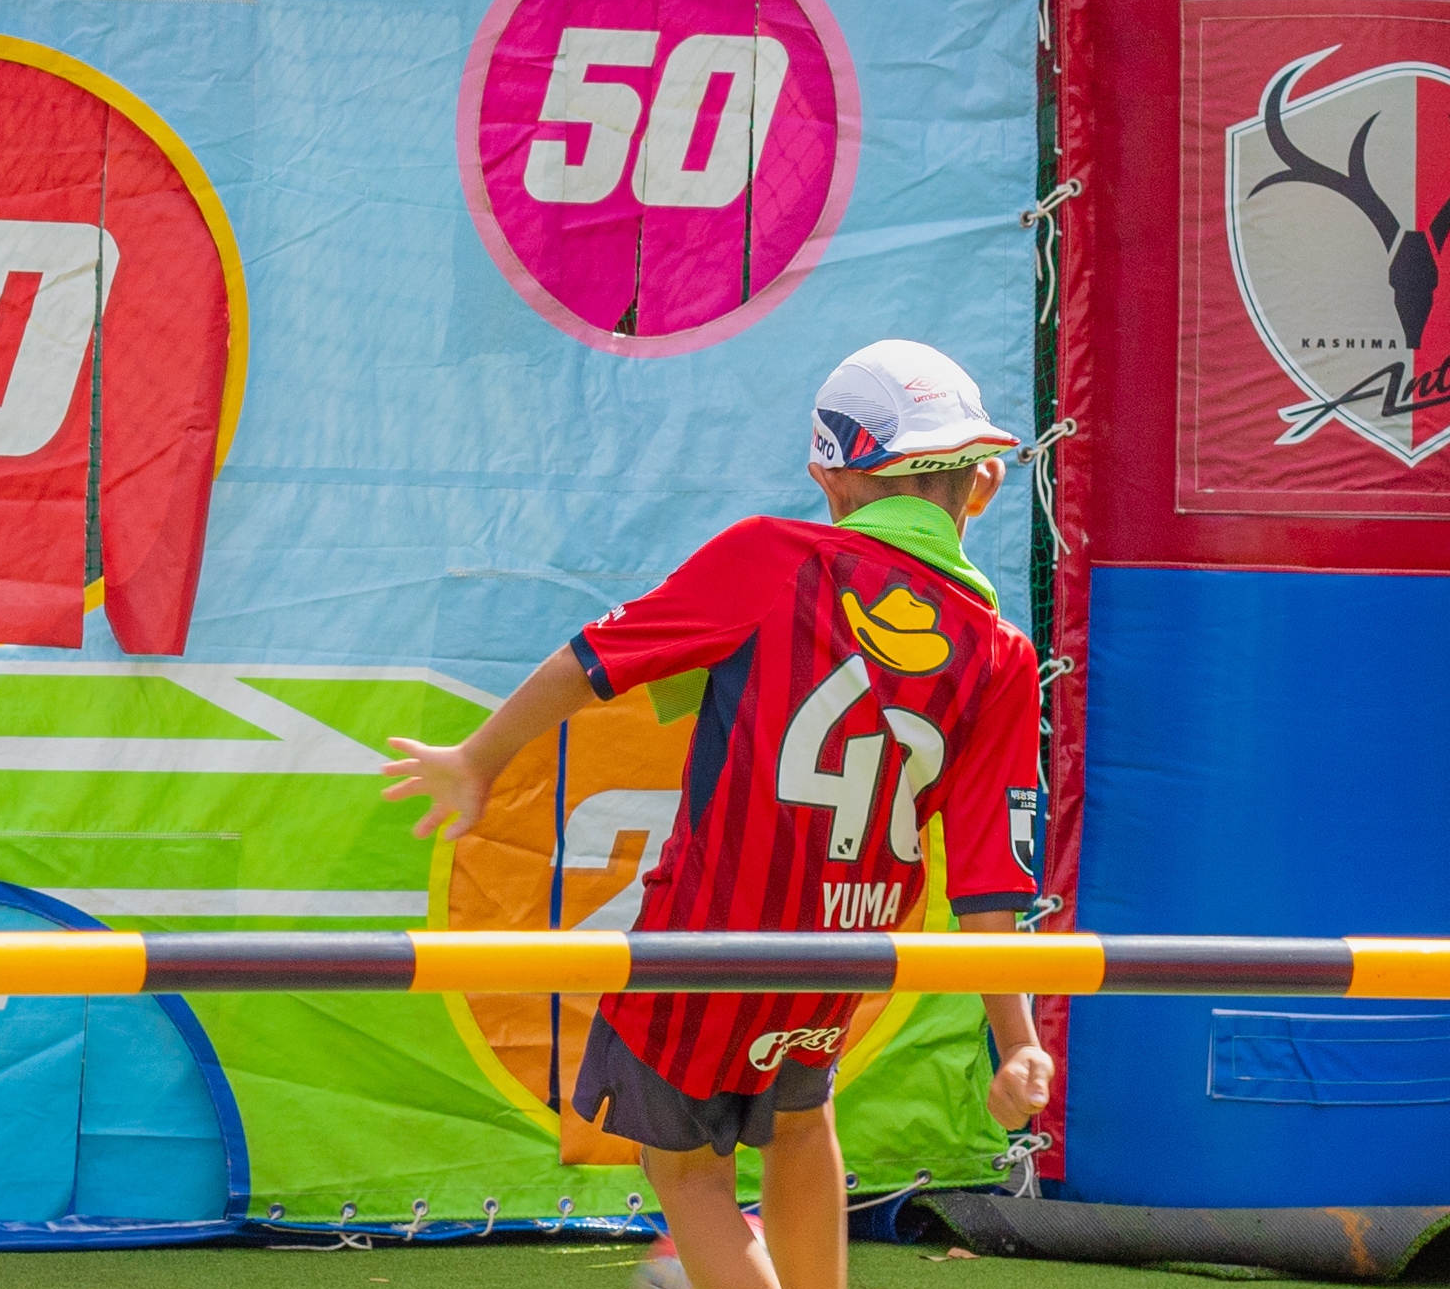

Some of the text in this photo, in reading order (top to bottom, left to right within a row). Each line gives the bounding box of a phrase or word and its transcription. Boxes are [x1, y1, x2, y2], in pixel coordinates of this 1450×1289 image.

[523, 27, 791, 208] 50
[1301, 337, 1398, 350] KASHIMA
[913, 390, 947, 404] umbro
[821, 881, 903, 929] YUMA
